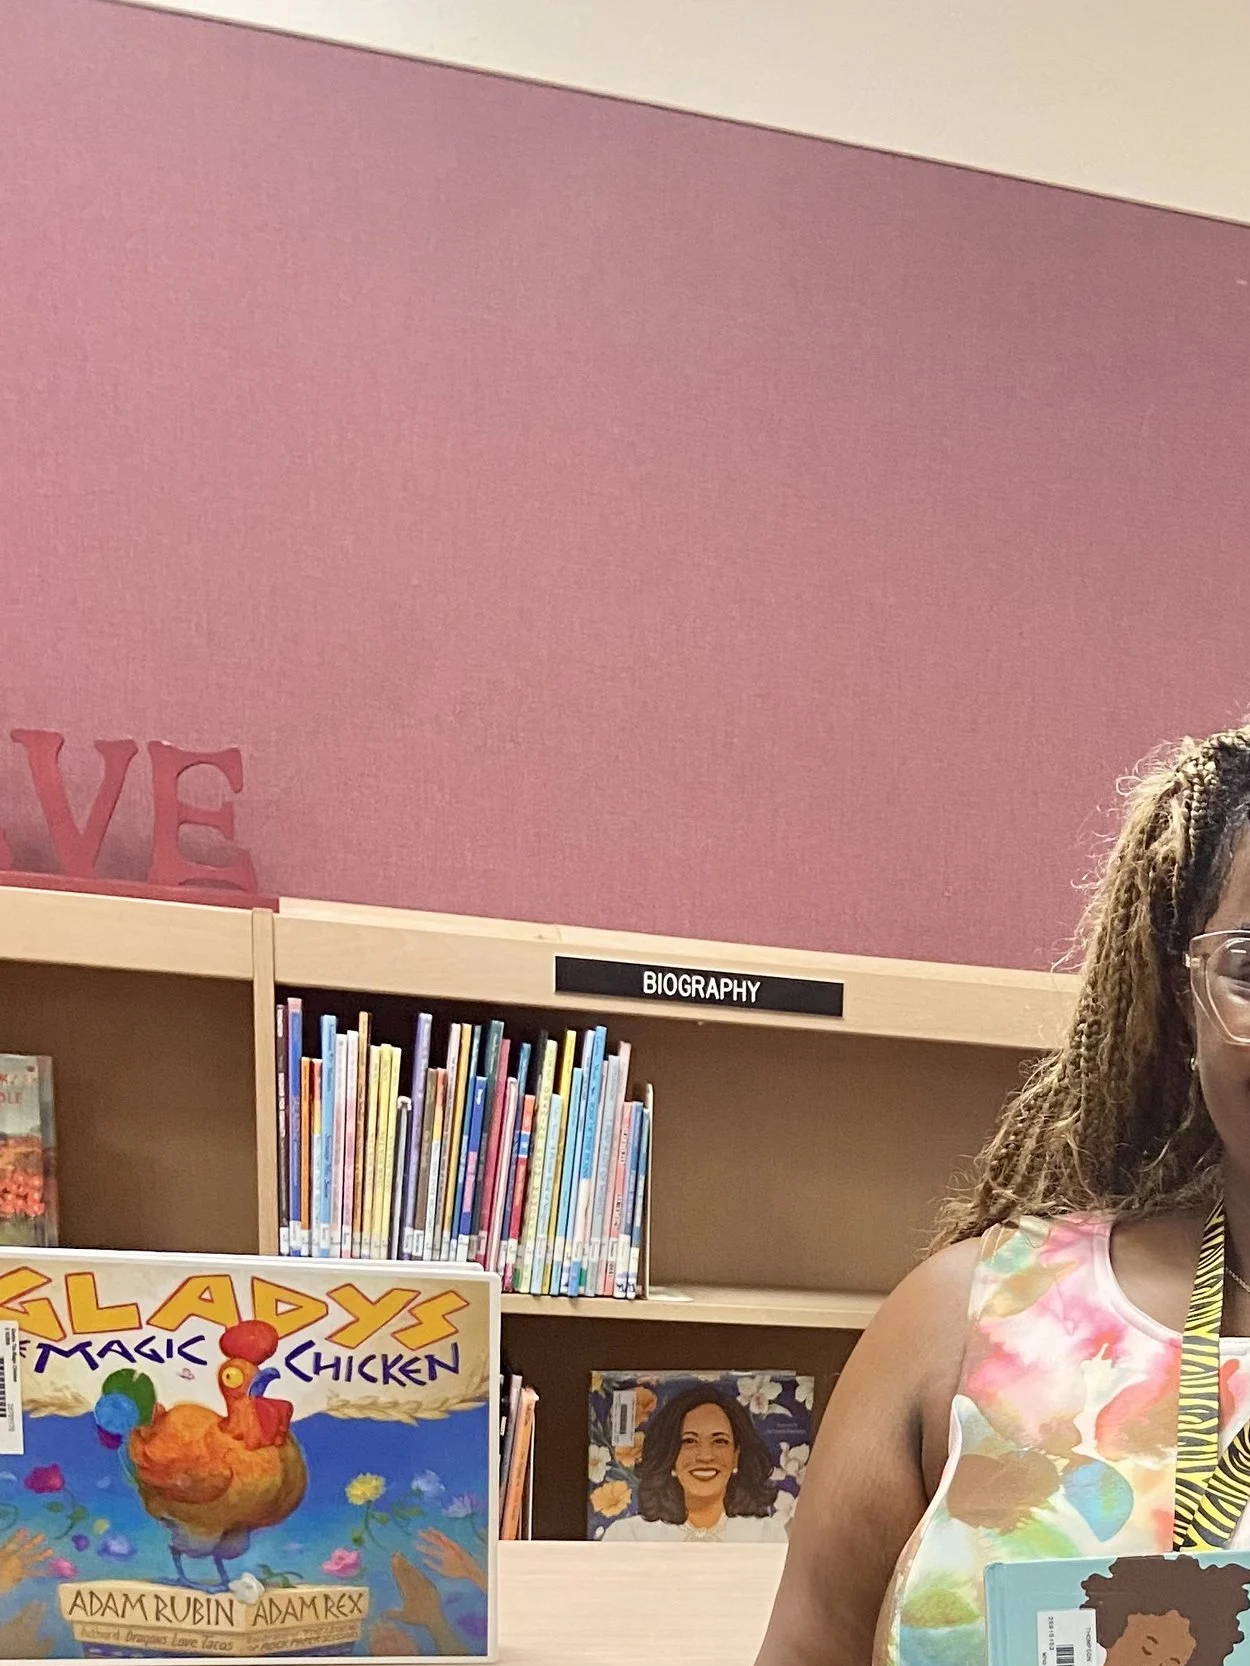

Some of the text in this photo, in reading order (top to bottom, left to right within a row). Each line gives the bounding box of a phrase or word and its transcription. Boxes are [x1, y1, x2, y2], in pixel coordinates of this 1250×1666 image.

[0, 728, 258, 896] VE
[643, 971, 761, 1003] BIOGRAPHY
[34, 1335, 207, 1373] MAGIC
[285, 1340, 459, 1387] CHICKEN
[68, 1590, 234, 1626] ADAM RUBIN
[252, 1592, 364, 1627] ADAM REX
[171, 1633, 198, 1648] Love
[201, 1635, 233, 1651] Tacos
